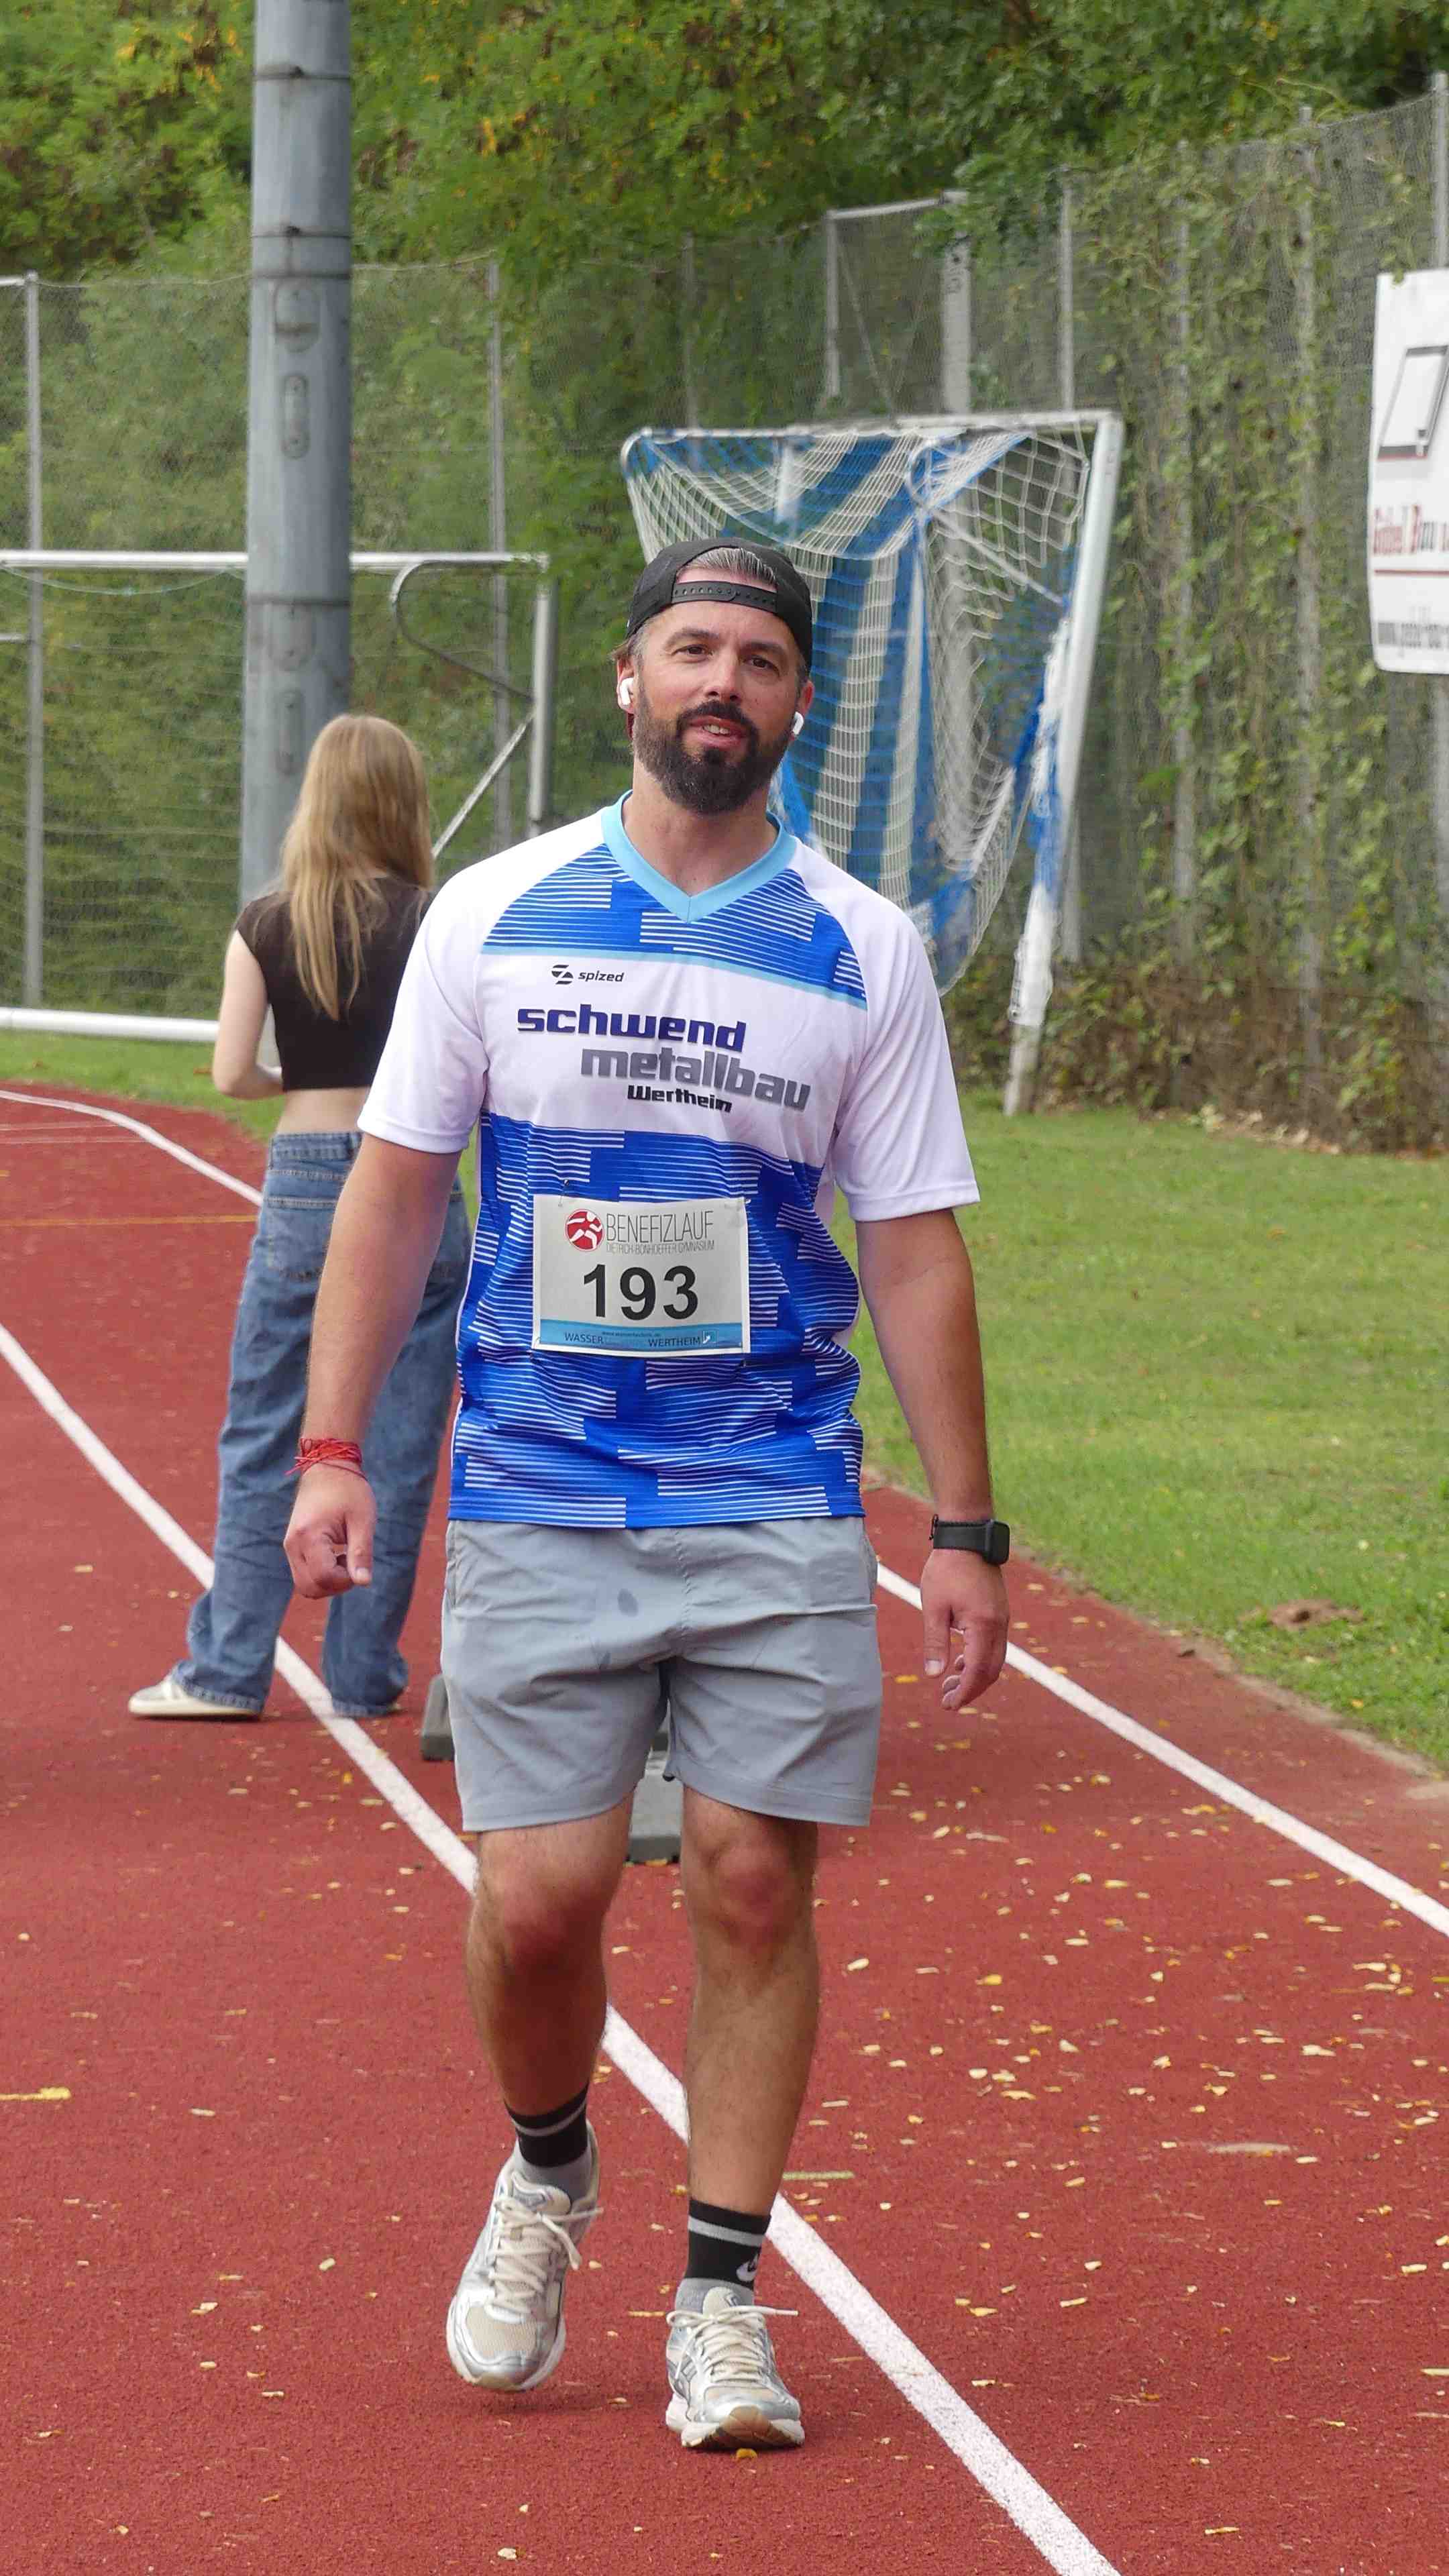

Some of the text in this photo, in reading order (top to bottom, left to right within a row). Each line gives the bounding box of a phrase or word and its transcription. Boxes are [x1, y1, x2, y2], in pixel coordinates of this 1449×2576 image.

[578, 969, 625, 983] spized
[517, 1004, 747, 1053] schwend
[581, 1047, 811, 1112] metallbau
[627, 1085, 733, 1113] Wertheim
[606, 1210, 714, 1243] BENEFIZLAUF
[584, 1264, 698, 1321] 193
[564, 1332, 603, 1344] WASSER
[648, 1335, 701, 1347] WERTHEIM
